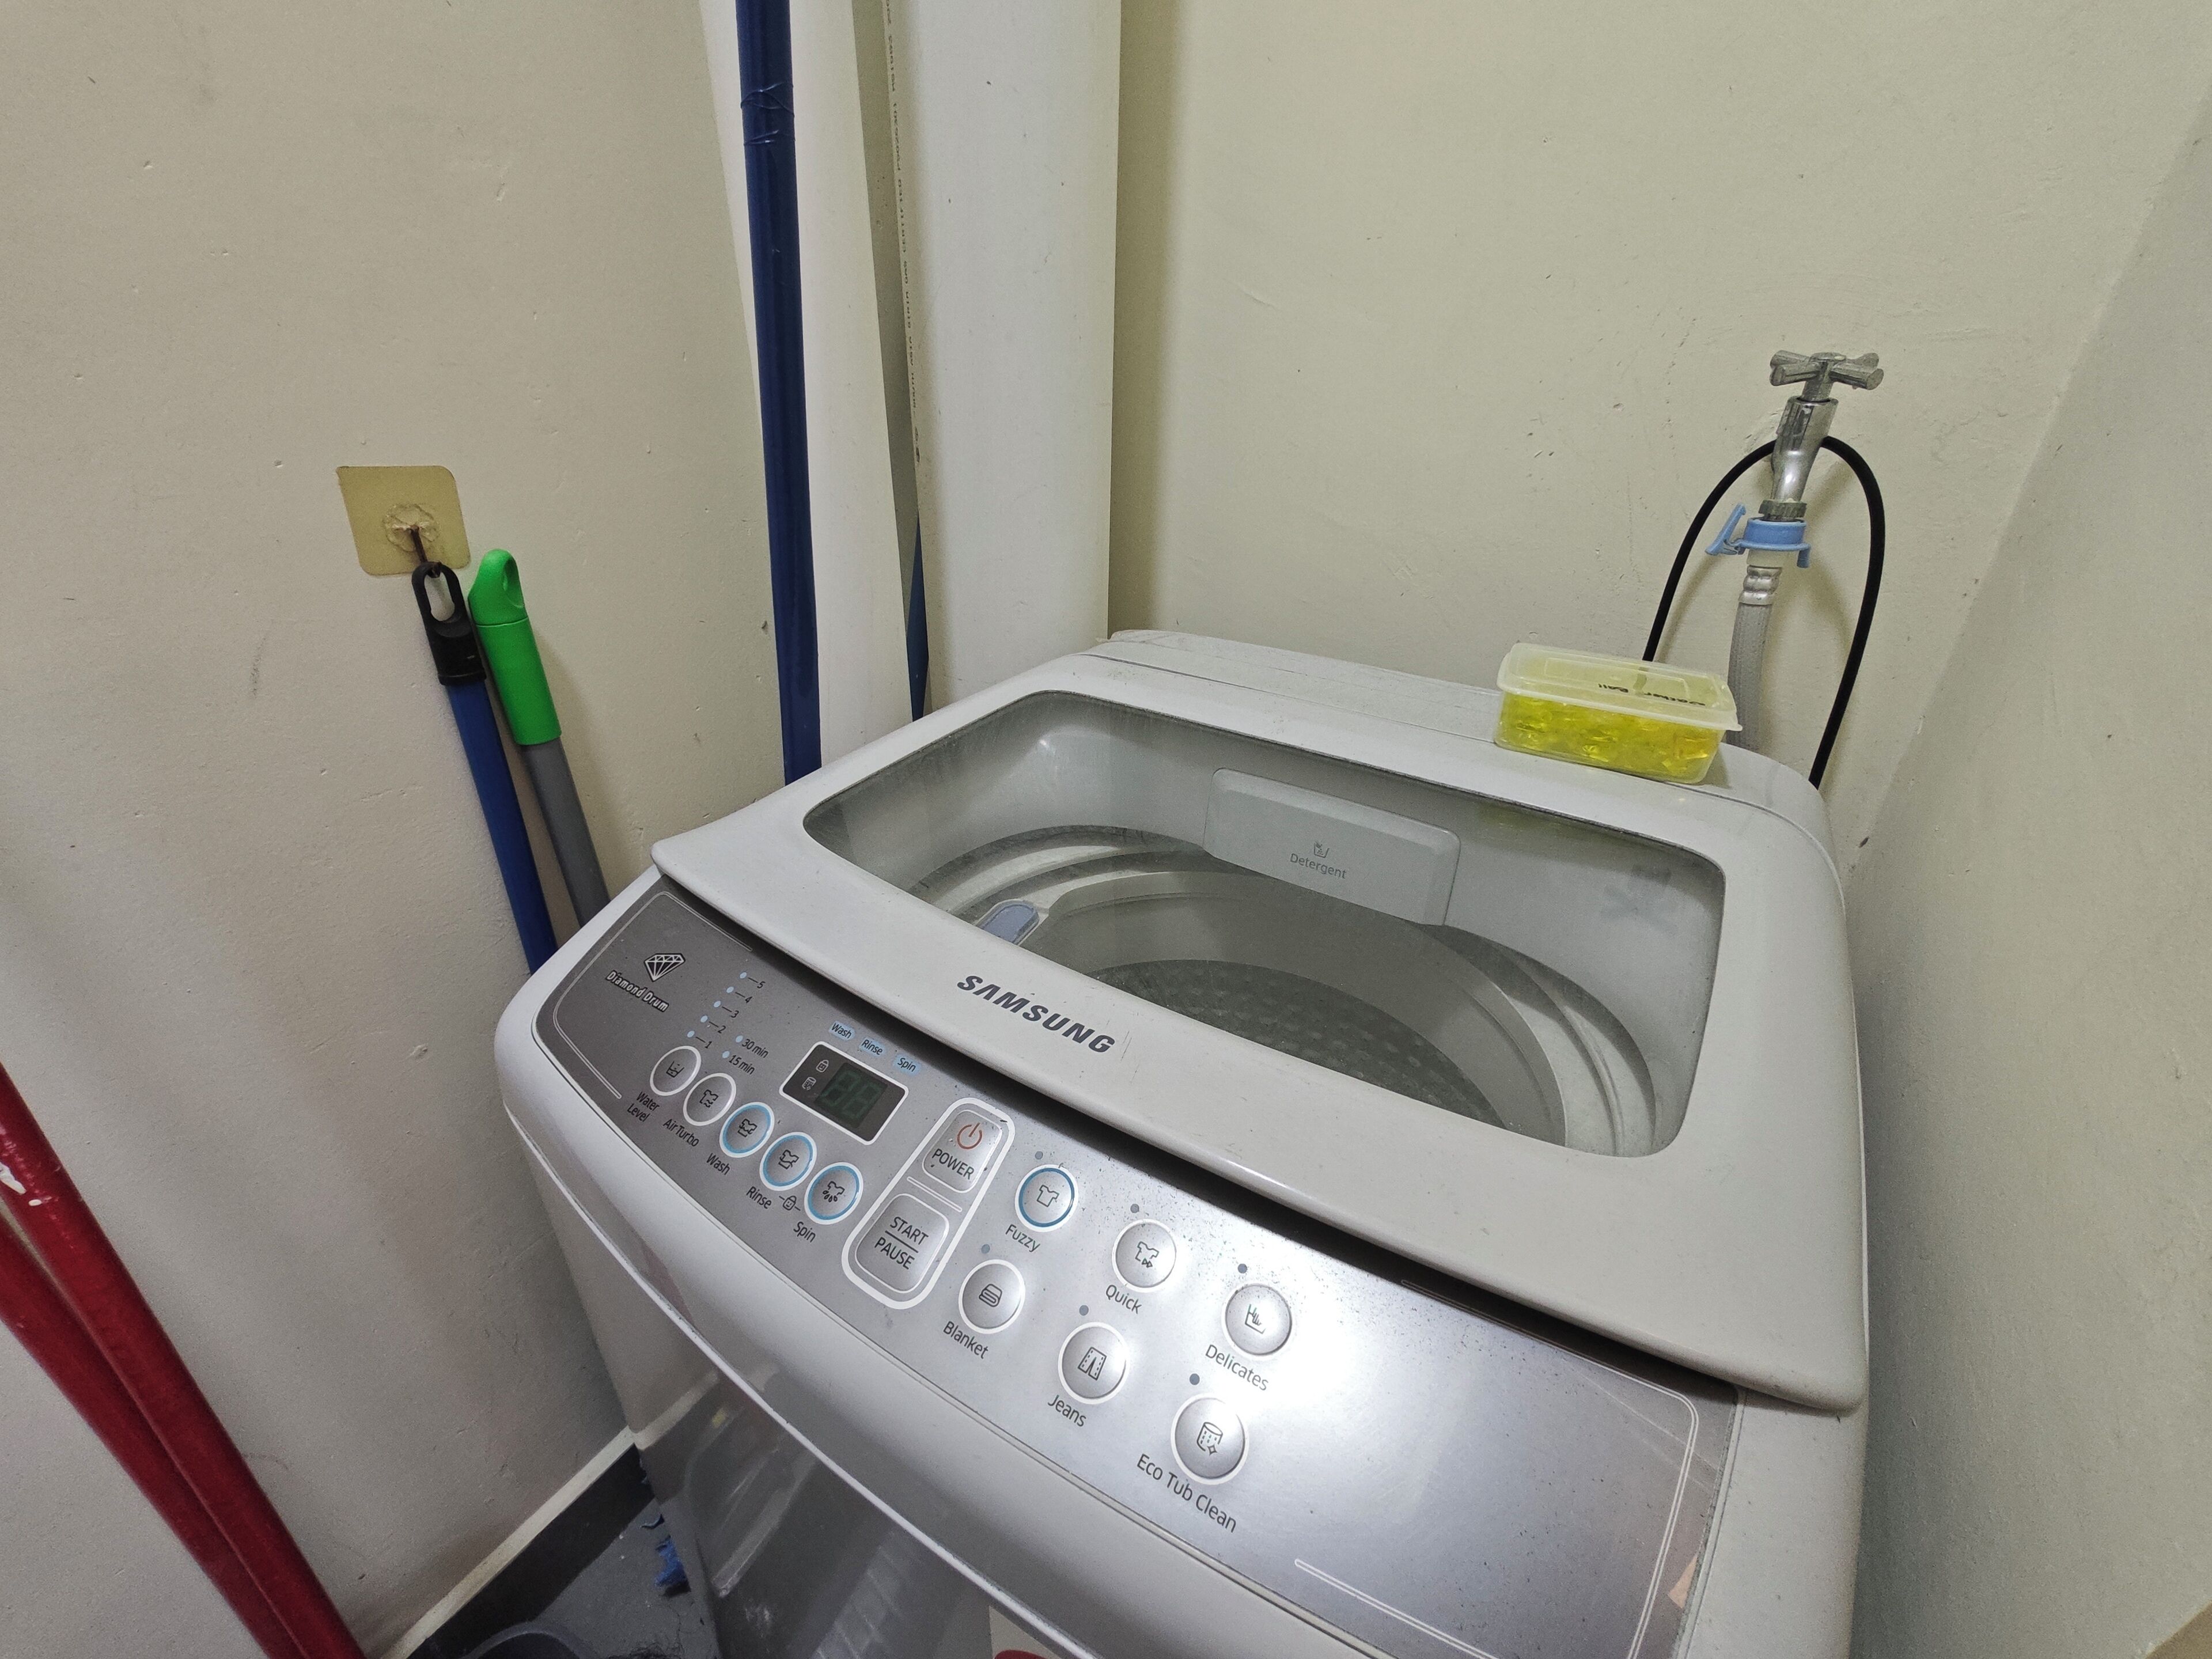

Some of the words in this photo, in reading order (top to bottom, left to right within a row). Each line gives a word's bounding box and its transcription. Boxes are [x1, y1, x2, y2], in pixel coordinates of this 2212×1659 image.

[1290, 853, 1346, 880] Detergent
[605, 969, 647, 998] Diamond
[642, 991, 669, 1012] Drum
[757, 981, 766, 989] 5
[957, 975, 1116, 1054] SAMSUNG
[717, 1025, 726, 1033] 2
[831, 1022, 852, 1039] Wash
[861, 1039, 883, 1055] Rinse
[897, 1058, 916, 1072] Spin
[627, 1103, 650, 1122] Level
[637, 1092, 660, 1111] Water
[663, 1119, 678, 1132] Air
[676, 1125, 699, 1147] Turbo
[706, 1153, 730, 1175] Wash
[931, 1148, 974, 1180] POWER
[746, 1186, 772, 1209] Rinse
[793, 1221, 816, 1243] Spin
[890, 1217, 929, 1245] START
[1005, 1224, 1041, 1252] Fuzzy
[874, 1237, 915, 1270] PAUSE
[1105, 1284, 1142, 1315] Quick
[943, 1321, 989, 1359] Blanket
[1205, 1344, 1269, 1391] Delicates
[1048, 1395, 1086, 1427] Jeans
[1137, 1453, 1163, 1480] Eco
[1166, 1472, 1193, 1501] Tub
[1196, 1494, 1237, 1533] Clean
